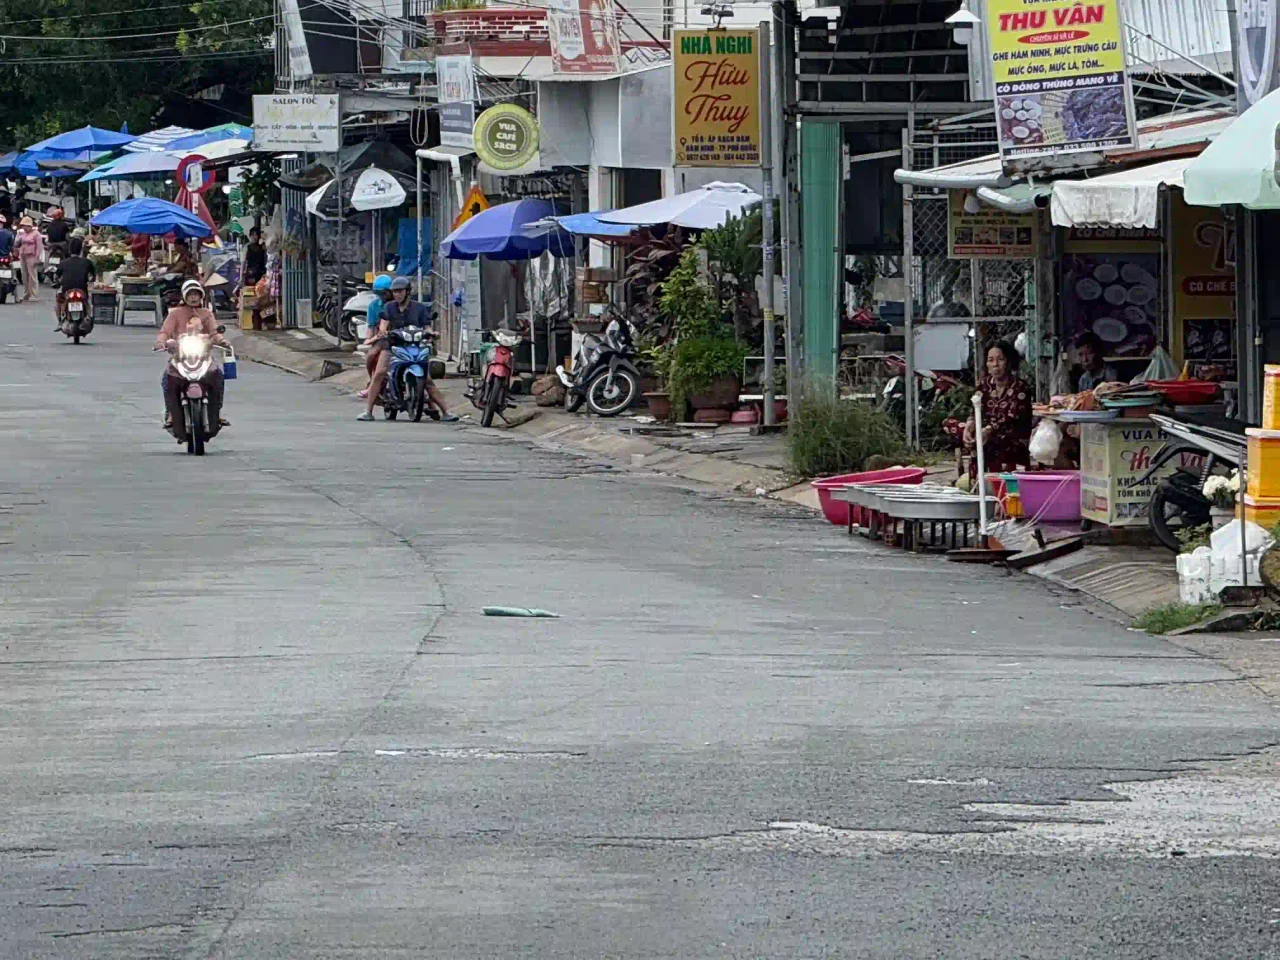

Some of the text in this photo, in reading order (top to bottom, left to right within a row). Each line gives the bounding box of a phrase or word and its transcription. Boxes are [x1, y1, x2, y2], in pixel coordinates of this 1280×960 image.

[998, 3, 1105, 32] THU VÂN
[681, 32, 753, 54] NHÀ NGHỈ
[1030, 47, 1052, 59] NINH,
[1053, 45, 1071, 57] MỰC
[1026, 61, 1047, 74] ỐNG,
[1048, 62, 1066, 74] MỰC
[684, 58, 750, 93] Hữu
[1076, 75, 1105, 87] MANG
[1106, 73, 1119, 84] VỀ
[301, 97, 318, 105] TÓC
[1136, 488, 1151, 497] KHÔ
